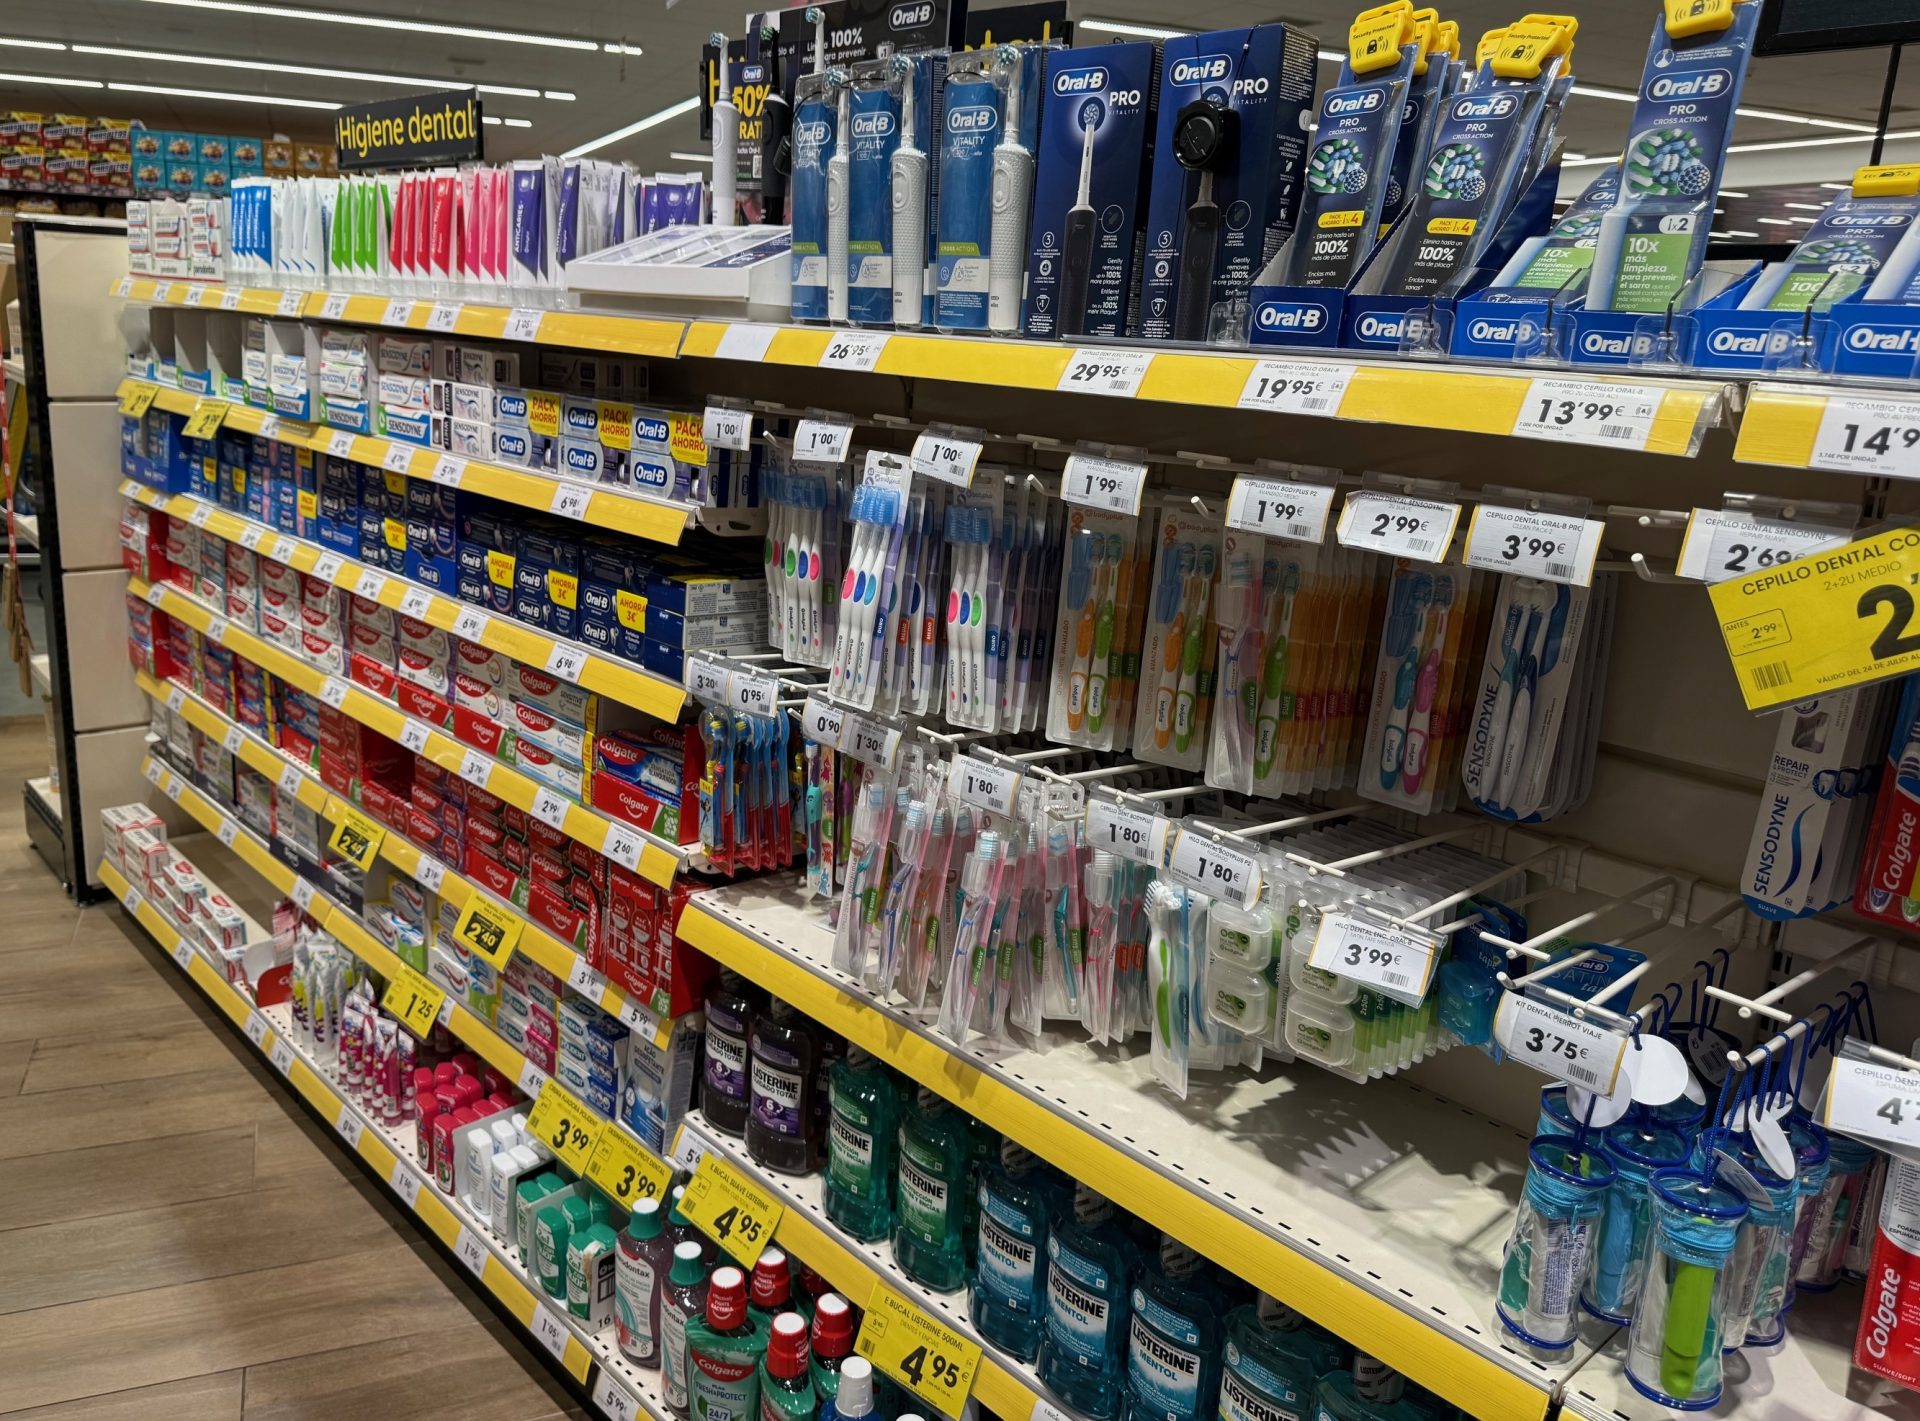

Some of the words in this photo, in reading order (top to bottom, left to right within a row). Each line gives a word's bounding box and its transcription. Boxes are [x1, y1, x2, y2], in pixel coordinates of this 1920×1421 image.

[892, 5, 929, 25] Oral-B
[831, 27, 862, 48] 100%
[1353, 30, 1372, 39] Security
[1373, 24, 1395, 35] Protected
[1174, 59, 1226, 81] Oral-B
[1057, 72, 1102, 91] Oral-B
[1233, 78, 1268, 96] PRO
[1653, 75, 1723, 97] Oral-B
[1109, 90, 1140, 107] PRO
[1328, 95, 1381, 114] Oral-B
[1456, 100, 1509, 118] Oral-B
[1669, 105, 1696, 116] PRO
[1339, 117, 1359, 128] PRO
[1466, 123, 1487, 132] PRO
[1653, 117, 1680, 125] CROSS
[1681, 116, 1708, 124] ACTION
[339, 115, 402, 157] Higiene
[408, 105, 476, 145] dental
[1328, 127, 1346, 136] CROSS
[1347, 126, 1367, 134] ACTION
[857, 141, 885, 149] VITALITY
[953, 136, 985, 146] VITALITY
[1832, 216, 1904, 225] Oral-B
[1314, 240, 1348, 254] 100%
[1419, 247, 1454, 261] 100%
[1543, 249, 1569, 258] 10x
[1629, 237, 1659, 253] 10x
[1626, 254, 1647, 263] más
[1621, 273, 1636, 282] para
[1637, 274, 1677, 282] prevenir
[1624, 264, 1667, 273] limpieza
[1261, 308, 1319, 327] Oral-B
[1713, 334, 1788, 352] Oral-B
[1071, 364, 1128, 381] 29'95€
[1257, 378, 1323, 398] 19'95€
[1543, 381, 1582, 389] RECAMBIO
[532, 397, 556, 413] PACK
[1539, 399, 1625, 425] 13'99€
[1846, 402, 1896, 412] RECAMBIO
[328, 411, 360, 427] SENSODYNE
[530, 410, 557, 424] AHORRO
[604, 408, 628, 424] PACK
[388, 418, 424, 437] SENSODYNE
[600, 425, 630, 436] AHORRO
[638, 422, 666, 439] Oral-B
[676, 420, 703, 436] PACK
[672, 438, 705, 451] AHORRO
[931, 444, 964, 462] 1'00€
[636, 465, 665, 483] Oral-B
[1085, 474, 1123, 495] 1'99€
[1245, 480, 1265, 489] CEPILLO
[1281, 486, 1309, 495] BODYPLUS
[1258, 500, 1304, 522] 1'99€
[1385, 495, 1408, 504] DENTAL
[1409, 498, 1445, 511] SENSODYNE
[1371, 514, 1429, 536] 2'99€
[1486, 511, 1513, 521] CEPILLO
[1515, 516, 1539, 525] DENTAL
[1542, 520, 1567, 529] ORAL-B
[1705, 517, 1738, 531] CEPILLO
[1740, 521, 1773, 535] DENTAL
[1774, 526, 1827, 541] SENSODYNE
[1502, 535, 1566, 560] 3'99€
[461, 553, 481, 568] Oral-B
[490, 558, 513, 571] AHORRA
[1742, 566, 1811, 595] CEPILLO
[1815, 544, 1885, 574] DENTAL
[520, 572, 541, 587] Oral-B
[551, 576, 576, 591] AHORRA
[1824, 574, 1855, 591] 2+2U
[1857, 561, 1902, 581] MEDIO
[620, 599, 646, 614] AHORRA
[1725, 621, 1750, 632] ANTES
[459, 641, 487, 659] Colgate
[1817, 672, 1846, 684] VÁLIDO
[1847, 669, 1861, 678] DEL
[1886, 656, 1909, 669] JULIO
[456, 674, 486, 694] Colgate
[521, 672, 552, 691] Colgate
[517, 708, 550, 727] Colgate
[472, 721, 494, 737] Colgate
[1467, 683, 1498, 787] SENSODYNE
[600, 740, 637, 761] Colgate
[856, 733, 883, 751] 1'30€
[1774, 756, 1810, 773] REPAIR
[968, 776, 998, 794] 1'80€
[619, 793, 649, 813] Colgate
[1109, 823, 1146, 843] 1'80€
[1188, 836, 1199, 844] HILO
[1200, 841, 1218, 852] DENTAL
[1218, 847, 1244, 863] BODYPLUS
[1753, 794, 1789, 895] SENSODYNE
[485, 865, 509, 887] Colgate
[1197, 857, 1240, 883] 1'80€
[1757, 903, 1777, 914] SUAVE
[586, 903, 597, 963] Colgate
[1344, 943, 1402, 967] 3'99€
[624, 970, 648, 991] Colgate
[1516, 1000, 1525, 1009] KIT
[1526, 1005, 1552, 1018] DENTAL
[1553, 1015, 1581, 1030] PIERROT
[1583, 1026, 1602, 1039] VIAJE
[705, 1027, 745, 1059] LISTERINE
[1526, 1028, 1590, 1060] 3'75€
[715, 1061, 723, 1072] 6
[752, 1062, 799, 1095] LISTERINE
[552, 1118, 594, 1150] 3'99€
[900, 1158, 944, 1199] LISTERINE
[713, 1205, 769, 1242] 4'95€
[981, 1216, 1031, 1263] LISTERINE
[985, 1242, 1017, 1270] MENTOL
[1048, 1266, 1106, 1319] LISTERINE
[710, 1304, 734, 1312] BACTERIA
[1054, 1293, 1089, 1325] MENTOL
[1866, 1268, 1900, 1359] Colgate
[598, 1317, 611, 1328] 16
[884, 1295, 911, 1318] E.BUCAL
[910, 1310, 941, 1338] LISTERINE
[941, 1331, 964, 1352] 500ML
[1132, 1321, 1195, 1375] LISTERINE
[698, 1358, 743, 1377] Colgate
[900, 1345, 969, 1386] 4'95€
[1139, 1349, 1178, 1381] MENTOL
[1873, 1363, 1917, 1383] SUAVE/SOFT
[708, 1409, 728, 1418] 24/7
